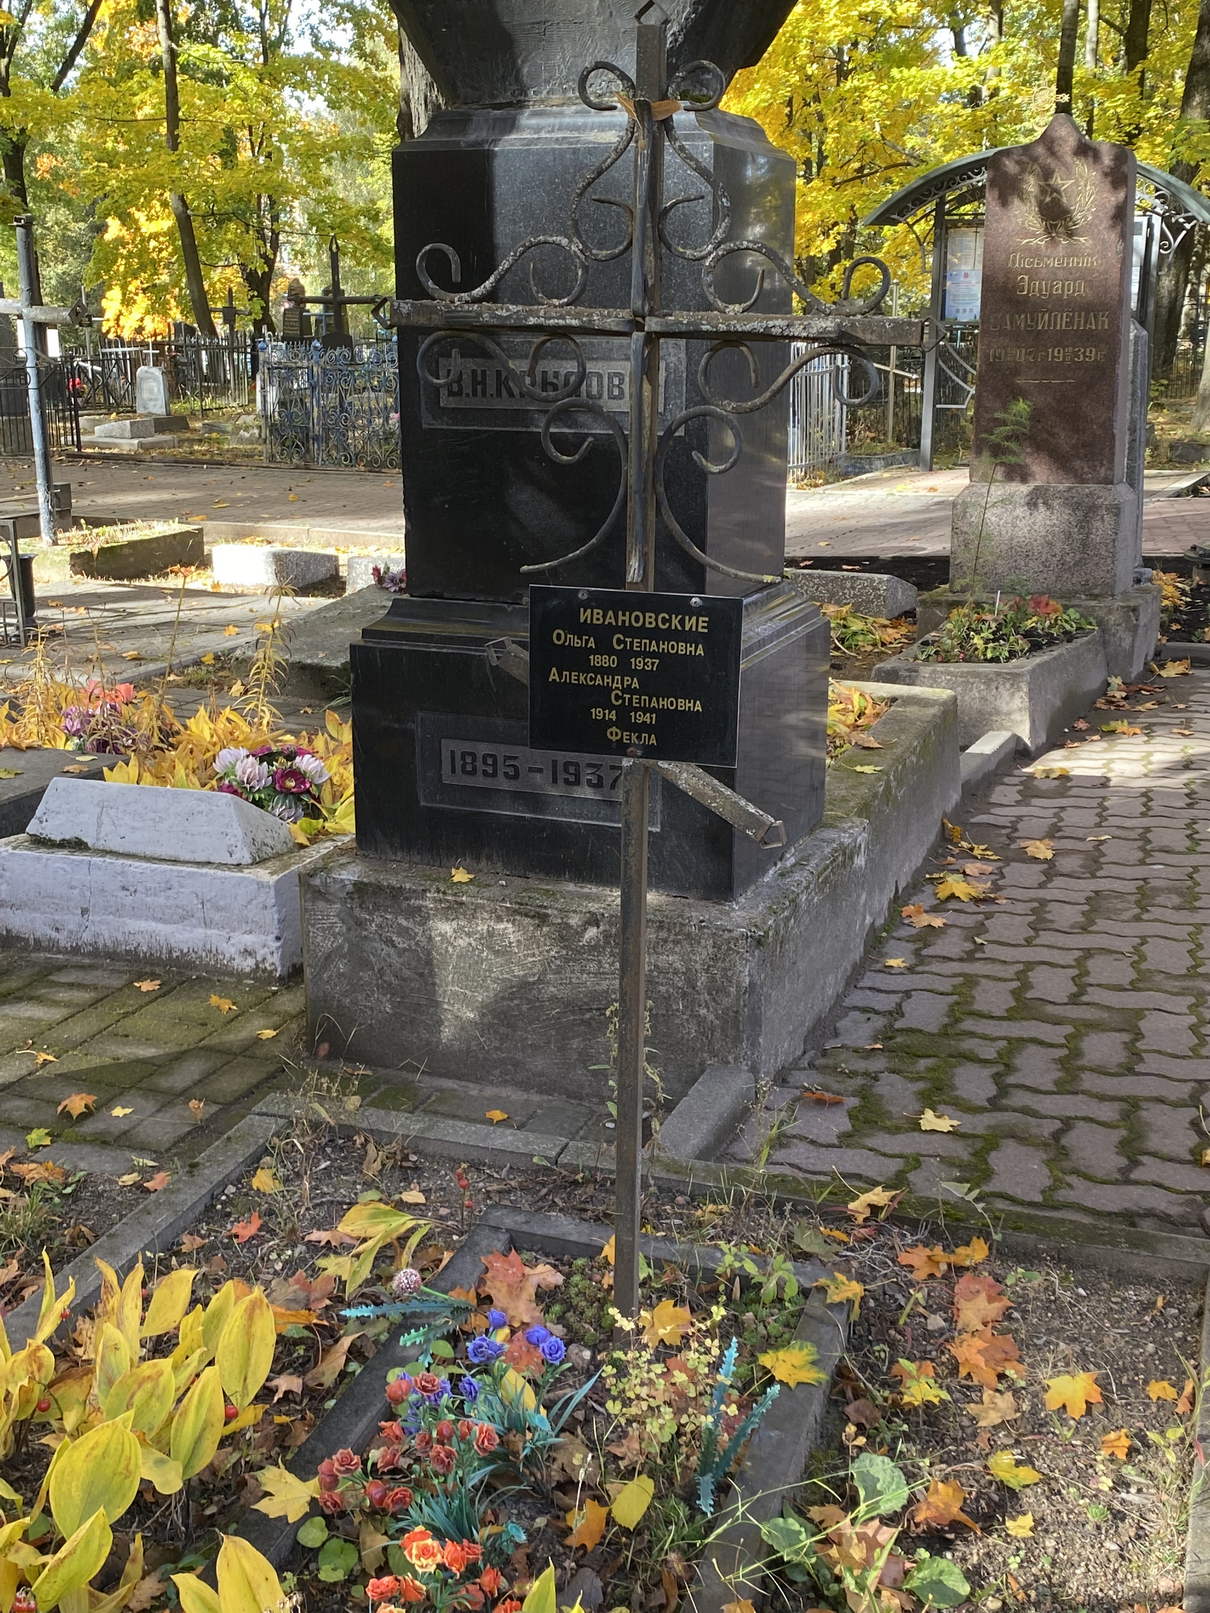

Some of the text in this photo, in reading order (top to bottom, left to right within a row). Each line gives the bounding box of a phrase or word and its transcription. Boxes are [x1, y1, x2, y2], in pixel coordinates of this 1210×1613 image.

[1016, 275, 1086, 299] Эдуард
[579, 607, 709, 633] ИВАНОВСКИЕ
[588, 654, 660, 671] 1880 1937
[590, 707, 657, 725] 1914 1941
